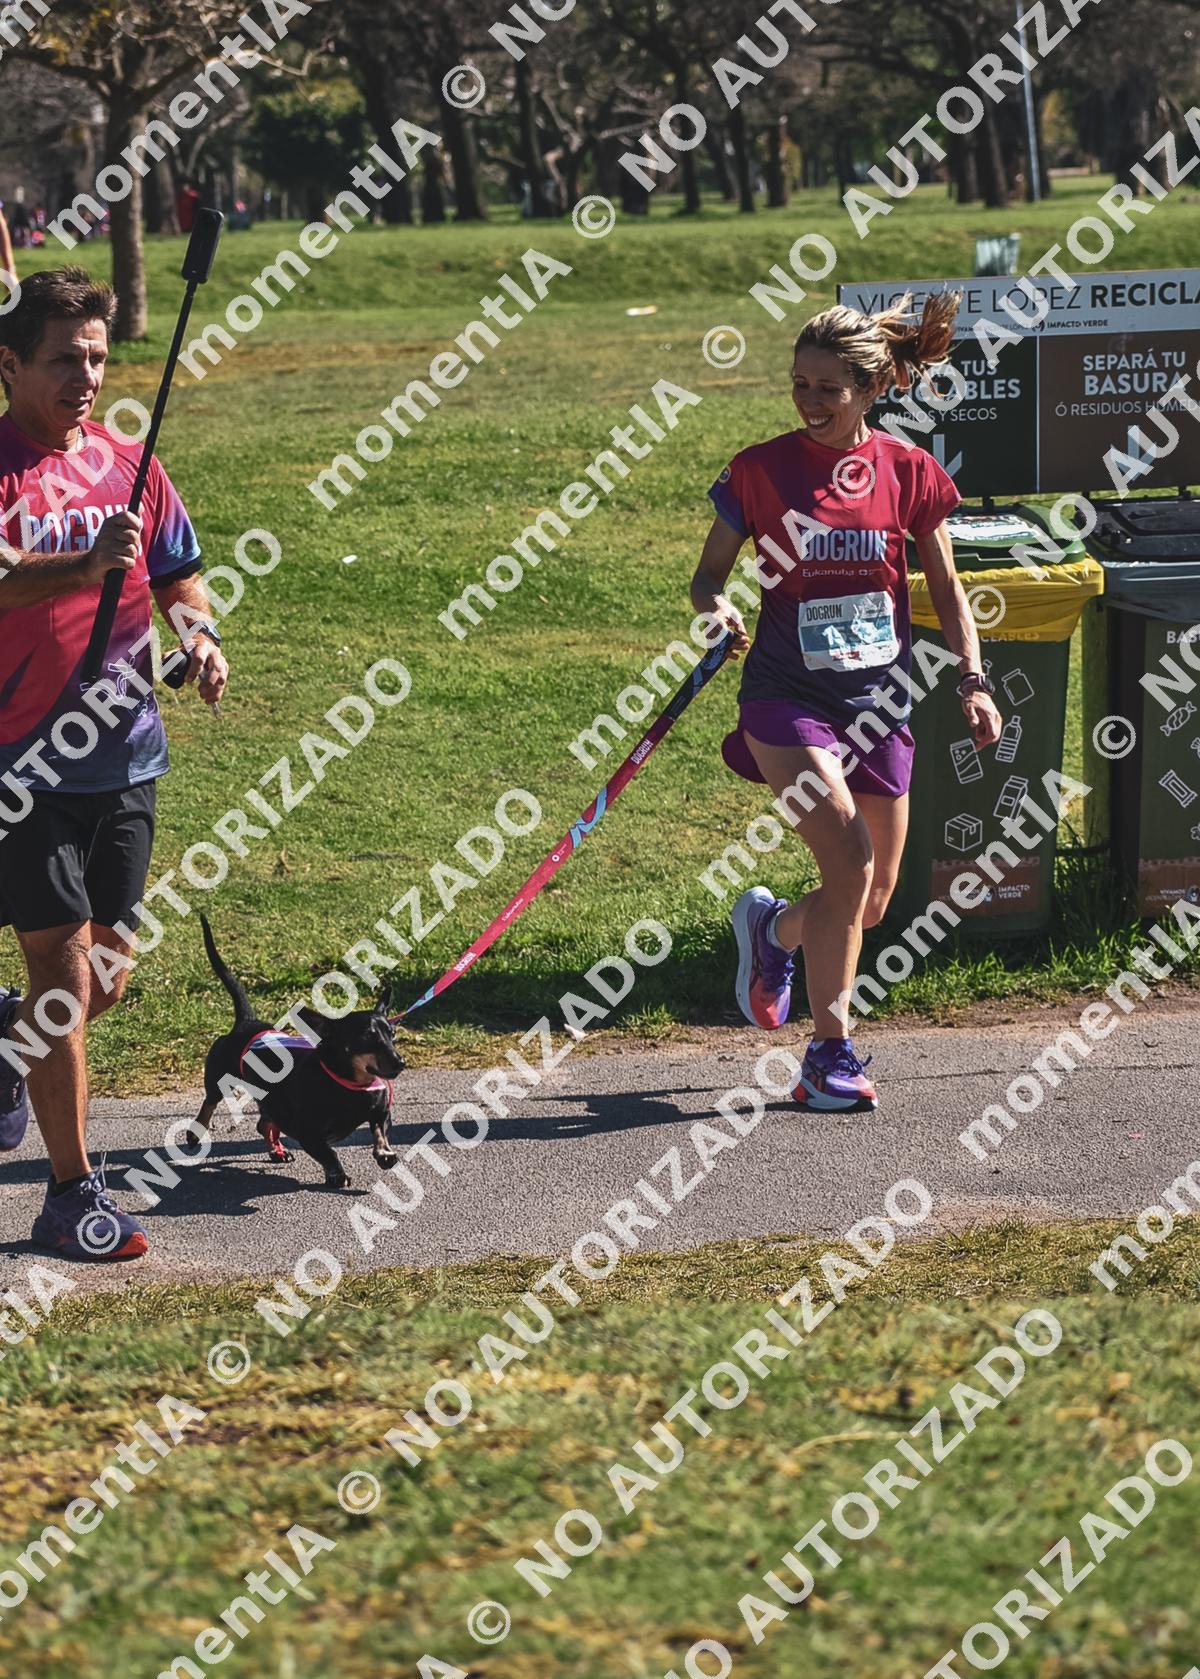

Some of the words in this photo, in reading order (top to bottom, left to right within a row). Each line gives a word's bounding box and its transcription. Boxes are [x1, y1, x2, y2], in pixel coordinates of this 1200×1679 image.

[857, 289, 982, 316] VICEE
[1047, 321, 1081, 329] IMPACTO
[1083, 319, 1109, 327] VERDE
[961, 359, 997, 376] TUS
[1083, 348, 1158, 371] SEPARÁ
[1162, 351, 1186, 368] TU
[1085, 371, 1186, 395] BASURA
[949, 407, 997, 421] SECOS
[1055, 401, 1068, 417] Ó
[1071, 401, 1142, 416] RESIDUOS
[800, 529, 888, 561] DOGRUN
[802, 568, 855, 578] Eukanuba
[806, 603, 843, 622] DOGRUN
[1166, 630, 1200, 644] BAS
[998, 884, 1030, 892] IMPACTO
[998, 891, 1022, 899] VERDE
